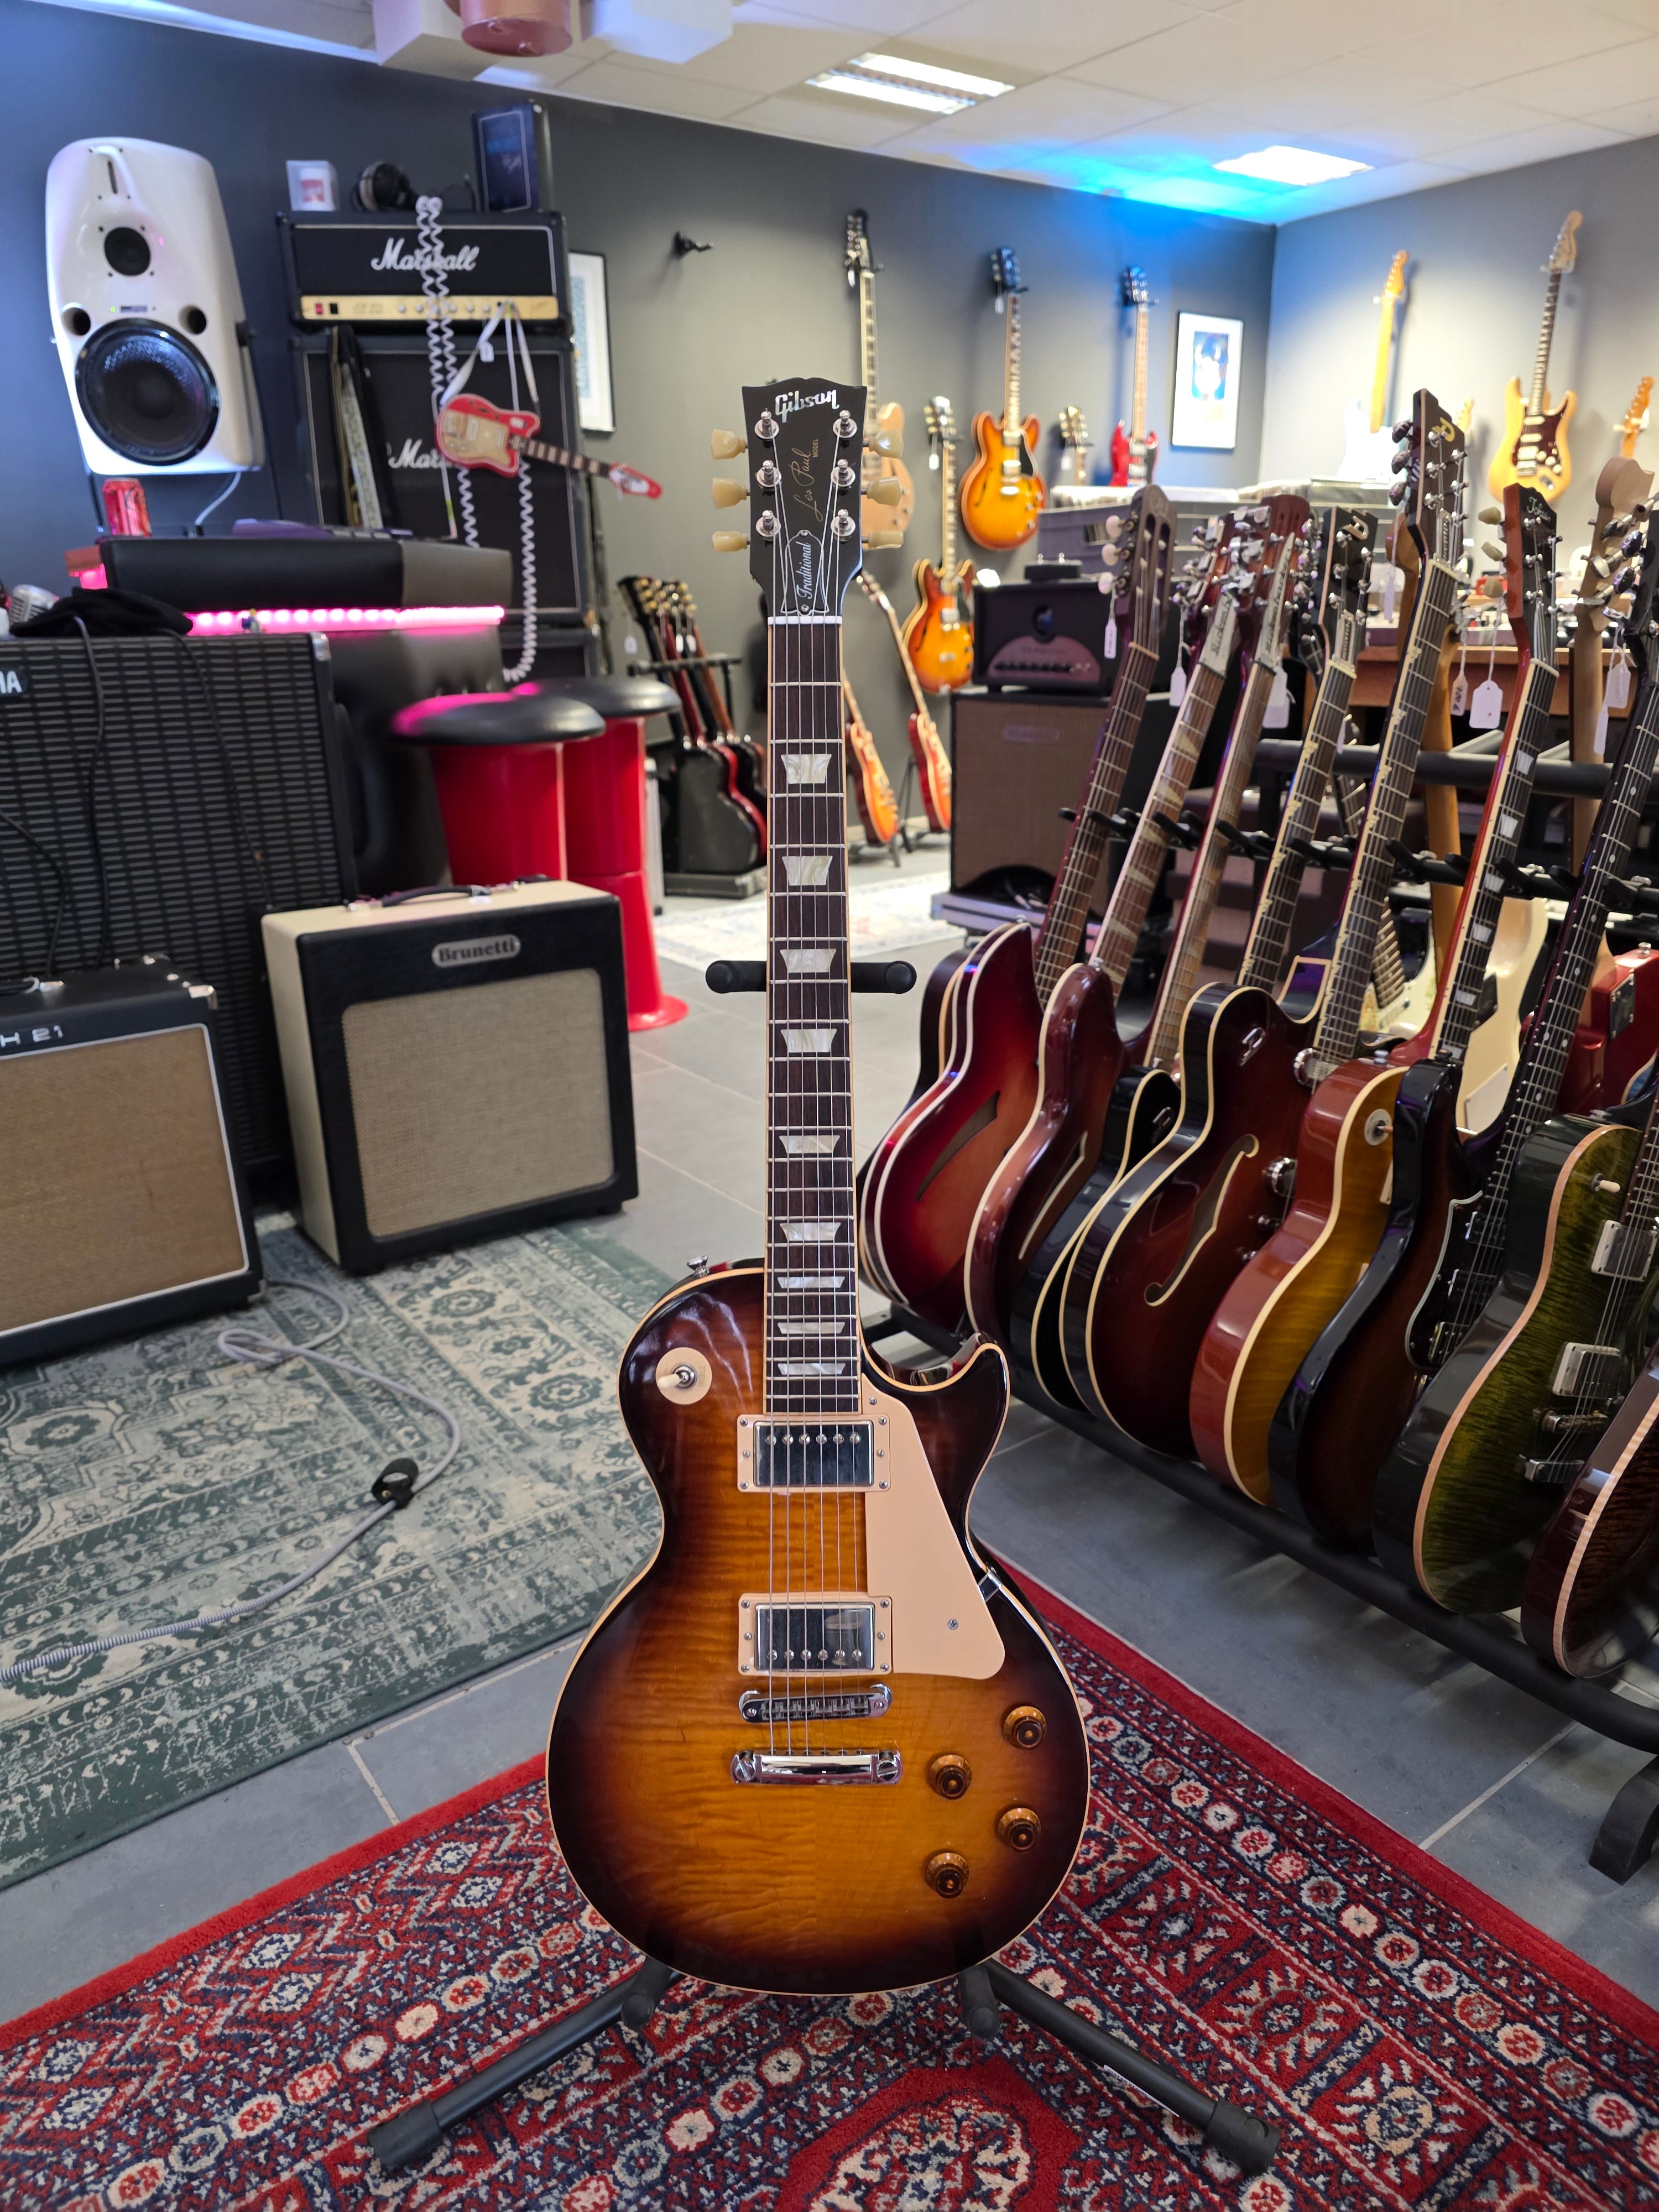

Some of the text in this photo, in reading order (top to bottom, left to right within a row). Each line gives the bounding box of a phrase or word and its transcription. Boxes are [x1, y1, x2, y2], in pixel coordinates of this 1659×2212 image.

[775, 389, 840, 423] Gibson
[788, 447, 823, 522] Les Paul
[795, 541, 813, 599] Traditional
[439, 938, 515, 962] Brunetti
